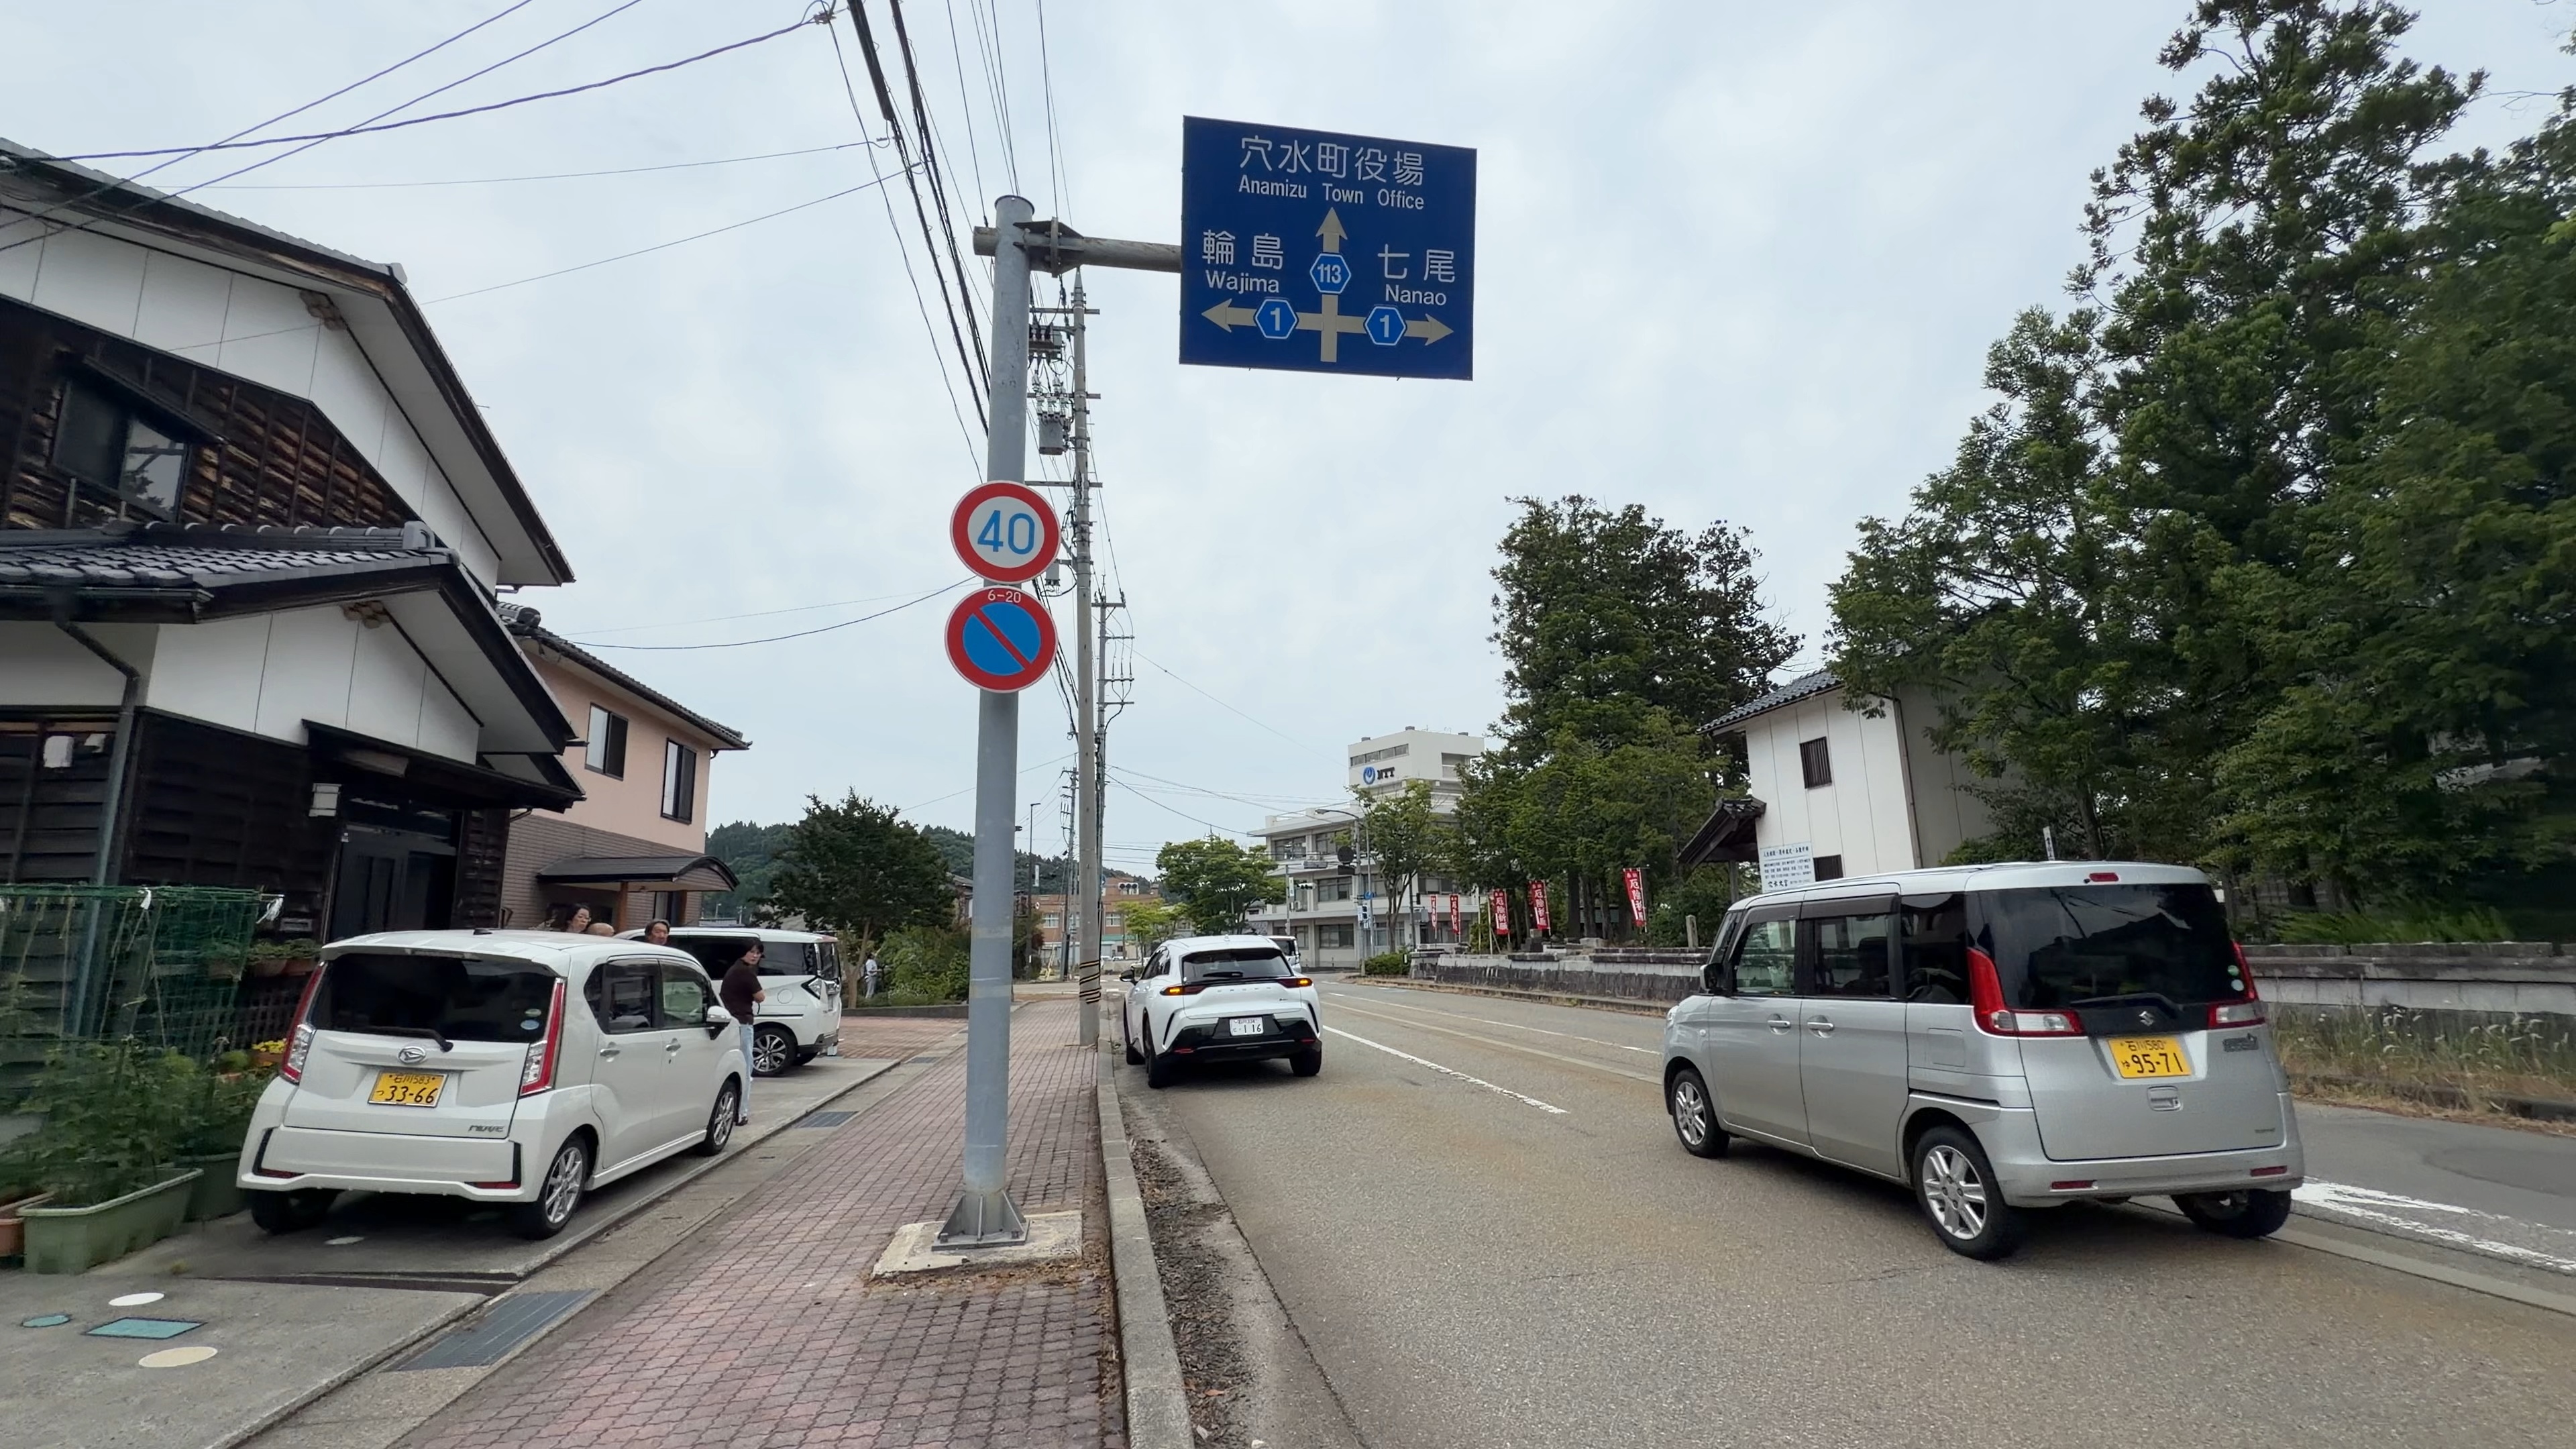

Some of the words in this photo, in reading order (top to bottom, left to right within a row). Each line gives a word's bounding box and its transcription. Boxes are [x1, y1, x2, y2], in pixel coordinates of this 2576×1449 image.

[1240, 136, 1424, 186] 穴水町役場
[1238, 174, 1307, 199] Anamizu
[1322, 183, 1363, 204] Town
[1377, 189, 1424, 210] Office
[1202, 230, 1284, 270] 輪島
[1317, 263, 1342, 284] 113
[1378, 244, 1455, 282] 七尾
[1205, 270, 1279, 294] Wajima
[1385, 284, 1446, 306] Nanao
[1270, 307, 1281, 331] 1
[1379, 315, 1390, 338] 1
[977, 510, 1035, 555] 40
[987, 589, 1021, 603] 6-20
[1377, 767, 1395, 780] NTT
[2131, 1053, 2183, 1073] 95-71
[385, 1085, 438, 1103] 33-66
